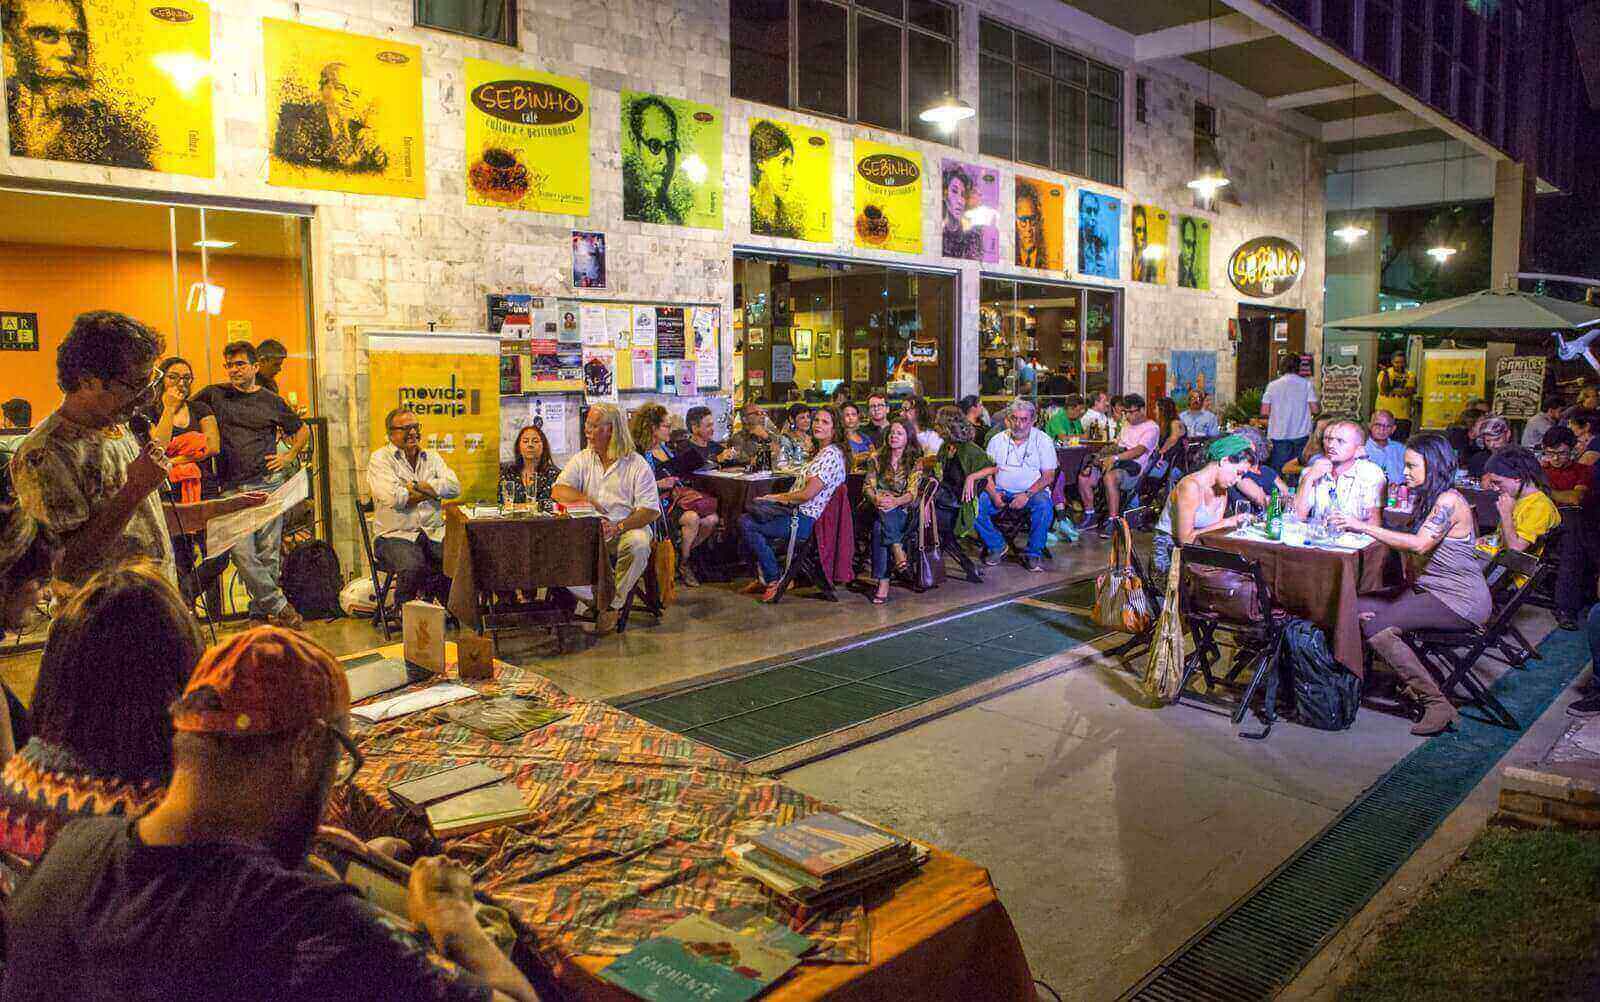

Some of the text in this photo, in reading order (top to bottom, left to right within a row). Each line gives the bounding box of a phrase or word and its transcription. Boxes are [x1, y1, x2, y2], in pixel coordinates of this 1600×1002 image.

[480, 85, 578, 113] SEBINHO
[862, 157, 917, 177] SEBINHO
[399, 374, 466, 400] movida
